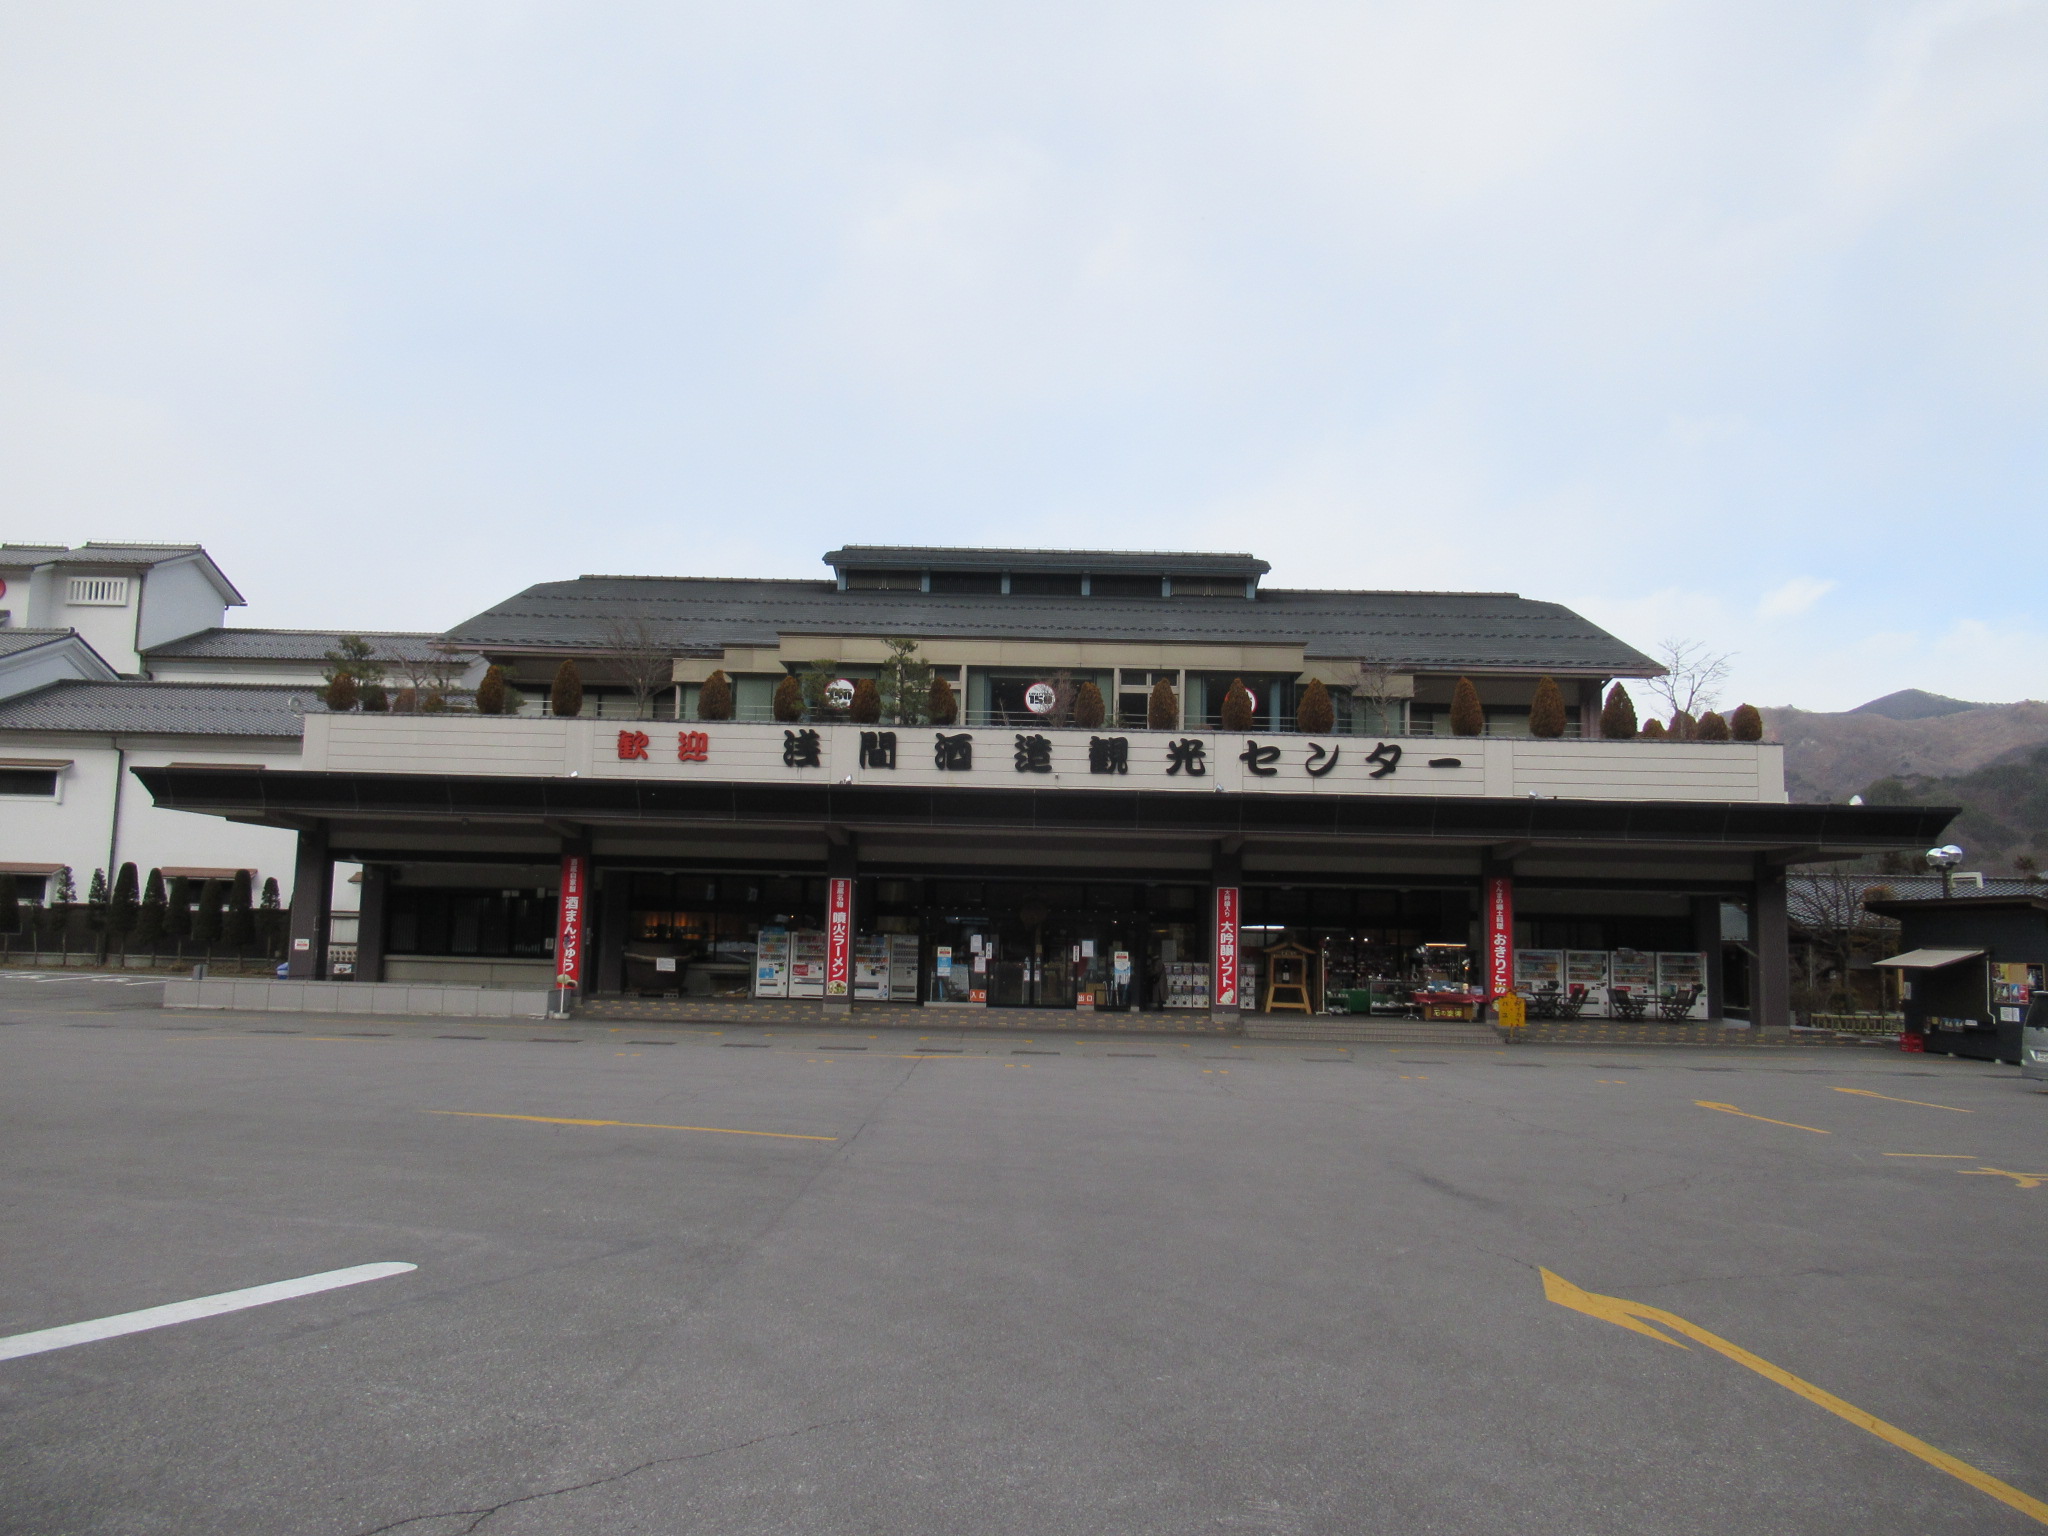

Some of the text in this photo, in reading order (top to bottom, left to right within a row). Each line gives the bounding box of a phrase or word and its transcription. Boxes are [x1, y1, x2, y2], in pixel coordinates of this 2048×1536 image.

[617, 729, 708, 762] 歓迎
[783, 729, 1462, 779] 浅間酒造観光センター
[1223, 889, 1231, 918] 大吟醸入り
[564, 896, 579, 972] 酒まんじゅう
[832, 911, 847, 978] 噴火ラーメン
[1220, 920, 1234, 988] 大吟醸ソフト
[971, 991, 985, 999] 入口
[1078, 994, 1093, 1002] 出口
